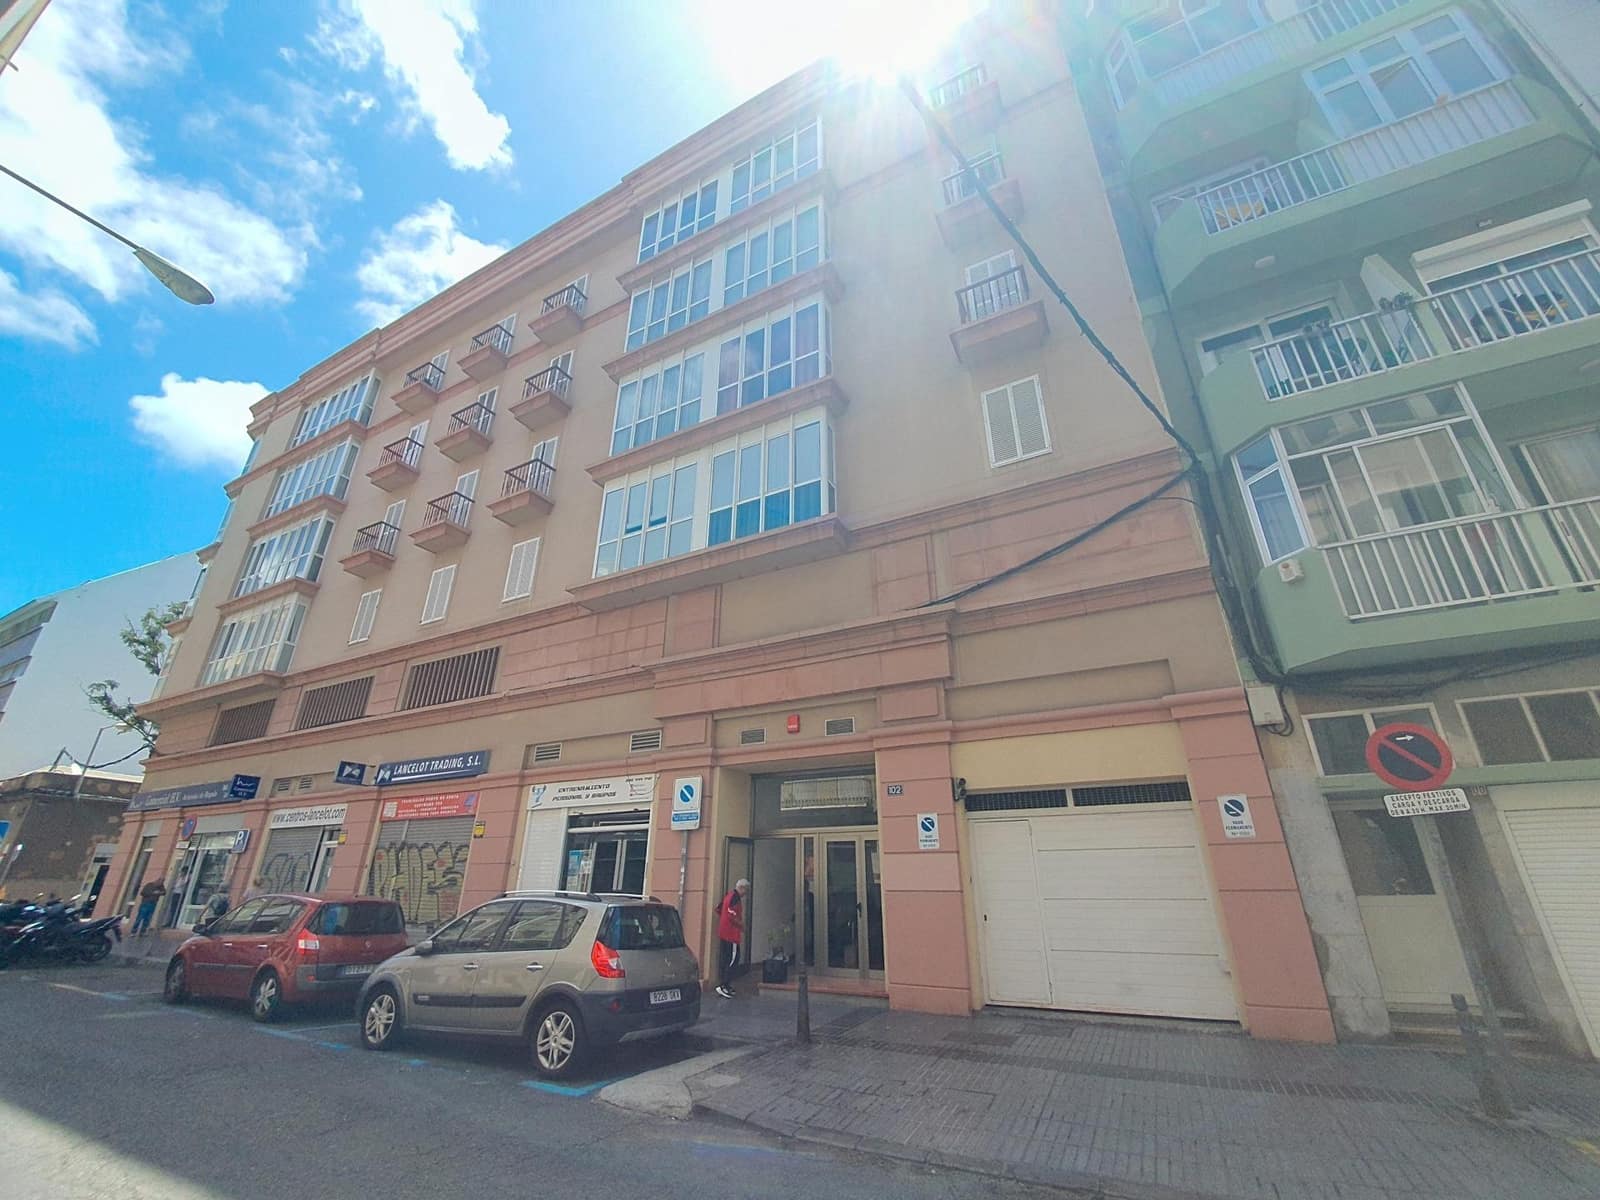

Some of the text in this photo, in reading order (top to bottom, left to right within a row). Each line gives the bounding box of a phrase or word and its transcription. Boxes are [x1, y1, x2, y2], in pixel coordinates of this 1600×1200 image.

[393, 755, 481, 775] LANCELOT TRADING, S.L.
[888, 785, 902, 794] 102
[1390, 790, 1456, 802] EXCEPTO FESTIVOS
[1391, 801, 1416, 809] CARGA
[1423, 796, 1460, 807] DESCARGA
